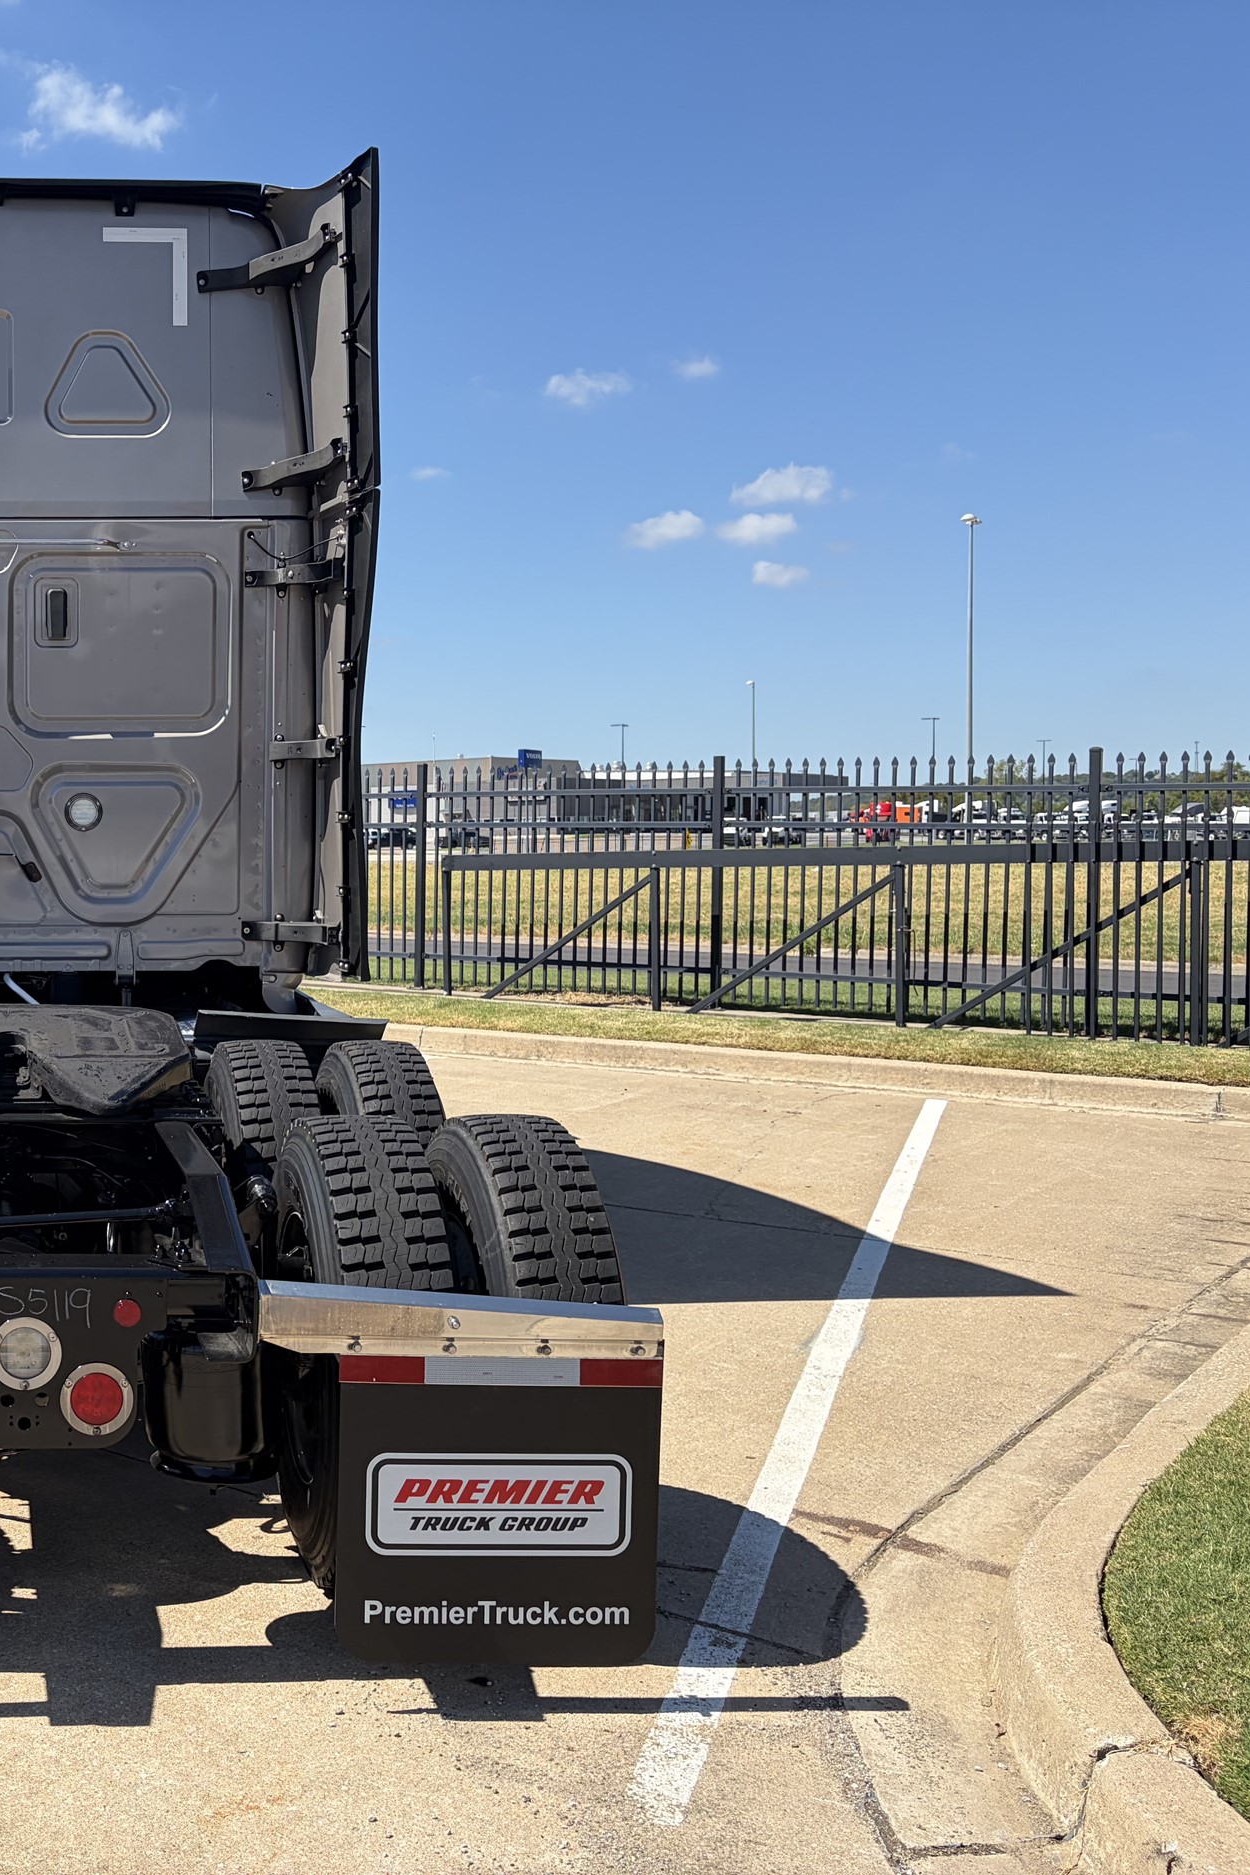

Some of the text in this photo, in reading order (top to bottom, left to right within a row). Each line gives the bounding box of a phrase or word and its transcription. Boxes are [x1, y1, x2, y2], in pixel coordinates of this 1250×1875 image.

[393, 1478, 605, 1504] PREMIER
[409, 1516, 588, 1531] TRUCK GROUP
[364, 1600, 630, 1625] PremierTruck.com
